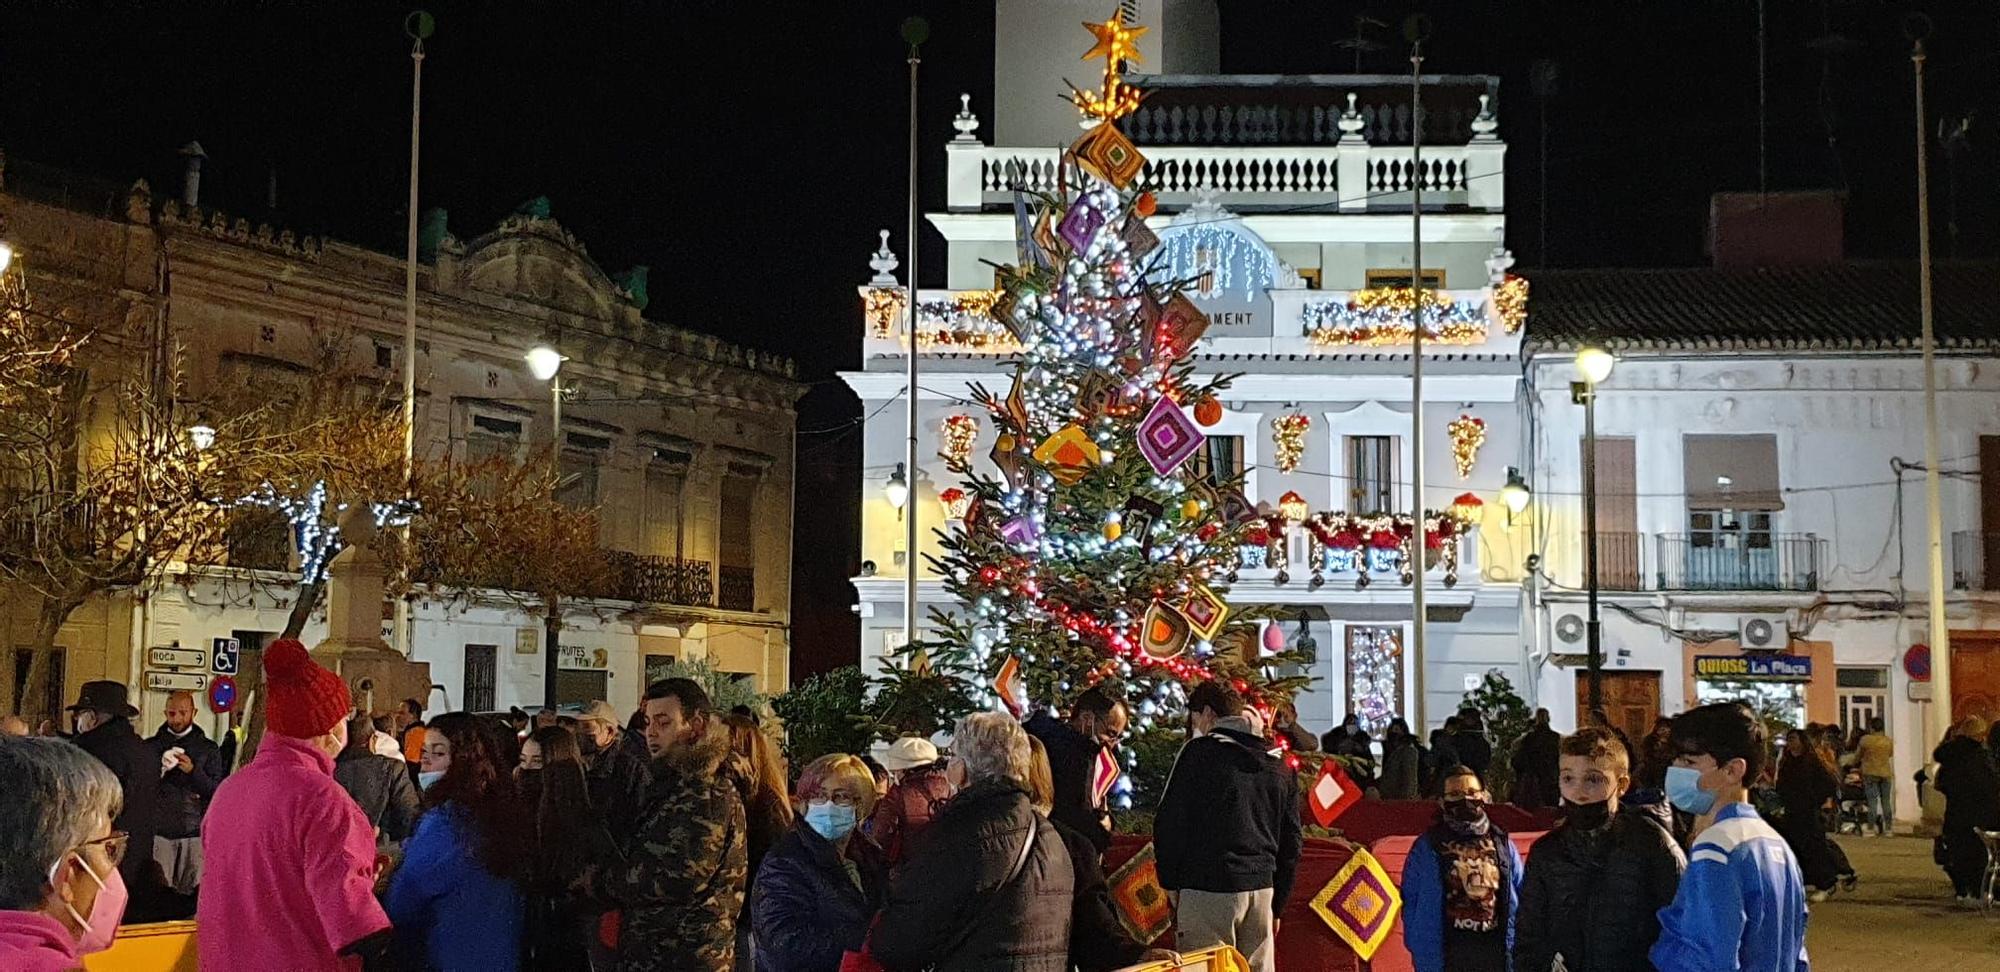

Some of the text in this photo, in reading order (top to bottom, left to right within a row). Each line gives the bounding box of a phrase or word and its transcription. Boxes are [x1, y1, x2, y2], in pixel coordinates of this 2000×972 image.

[153, 651, 175, 661] ROCA
[1698, 659, 1747, 673] QUIOSC
[1751, 661, 1768, 674] La
[1454, 919, 1480, 931] NOT
